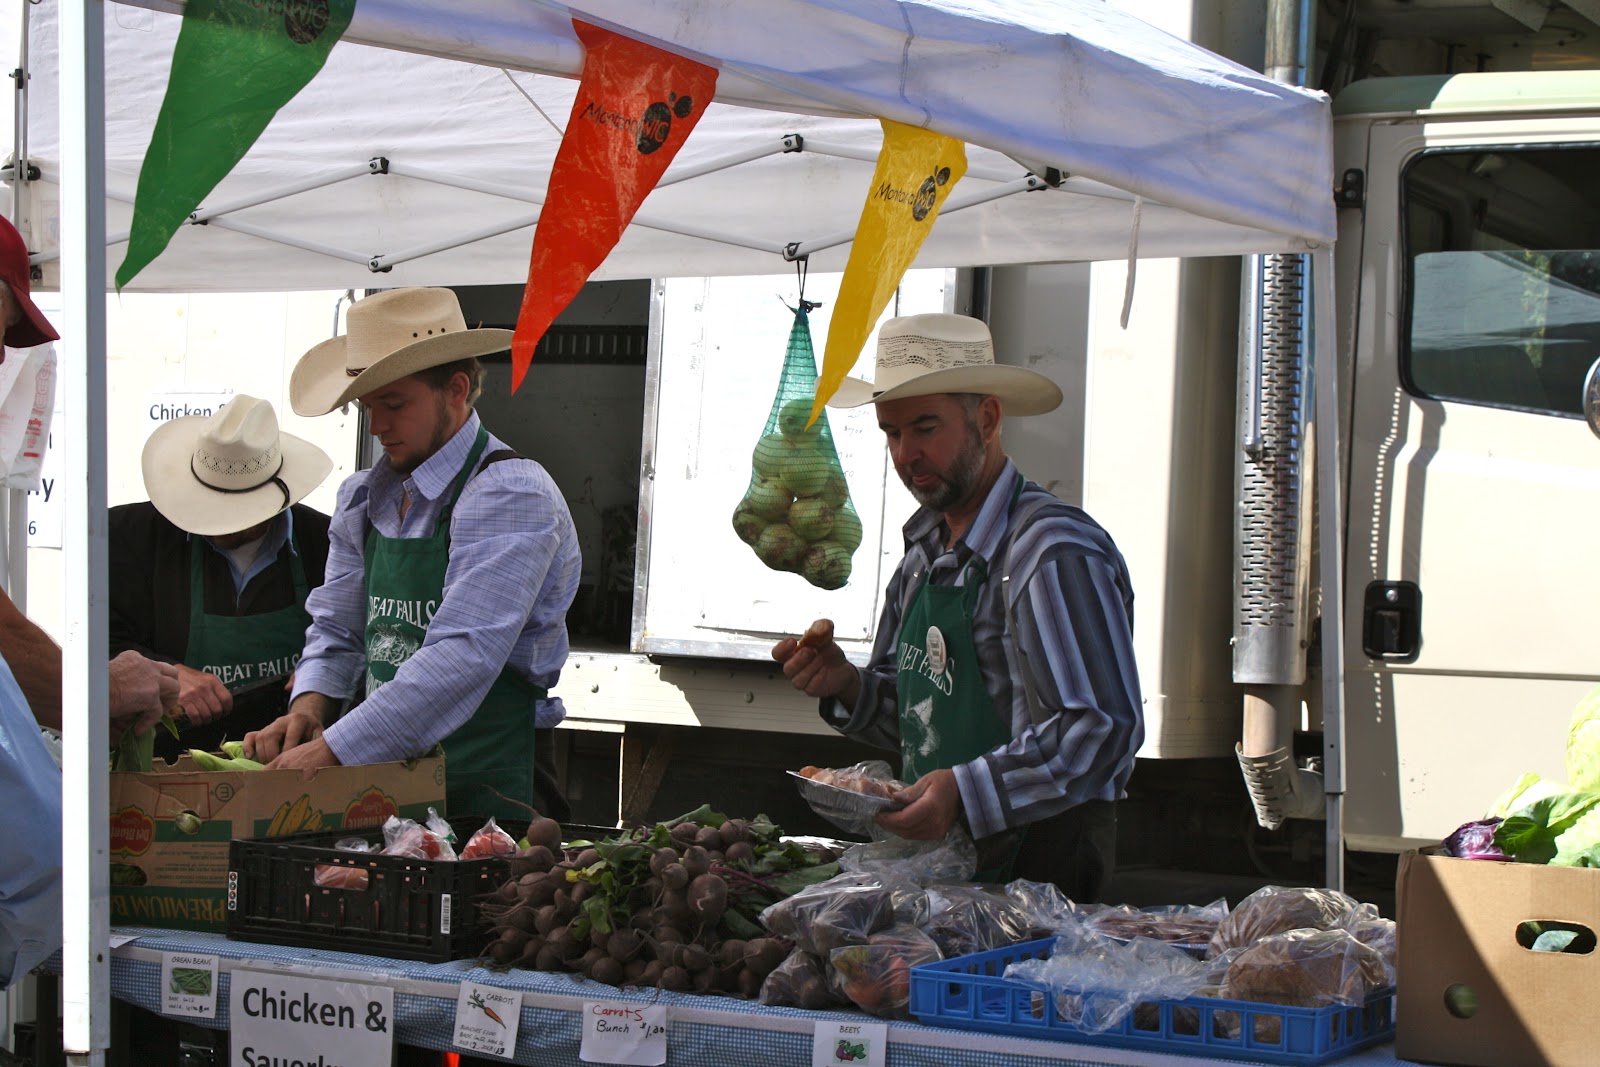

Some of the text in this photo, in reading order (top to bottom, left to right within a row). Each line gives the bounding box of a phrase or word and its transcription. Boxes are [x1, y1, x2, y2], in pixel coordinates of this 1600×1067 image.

[640, 119, 669, 142] WIC
[368, 595, 395, 625] REAT
[110, 826, 135, 840] Mont
[129, 895, 225, 922] PREMIUM
[243, 987, 387, 1033] Chicken &
[596, 1019, 630, 1034] Bunch
[839, 1025, 861, 1034] BEETS
